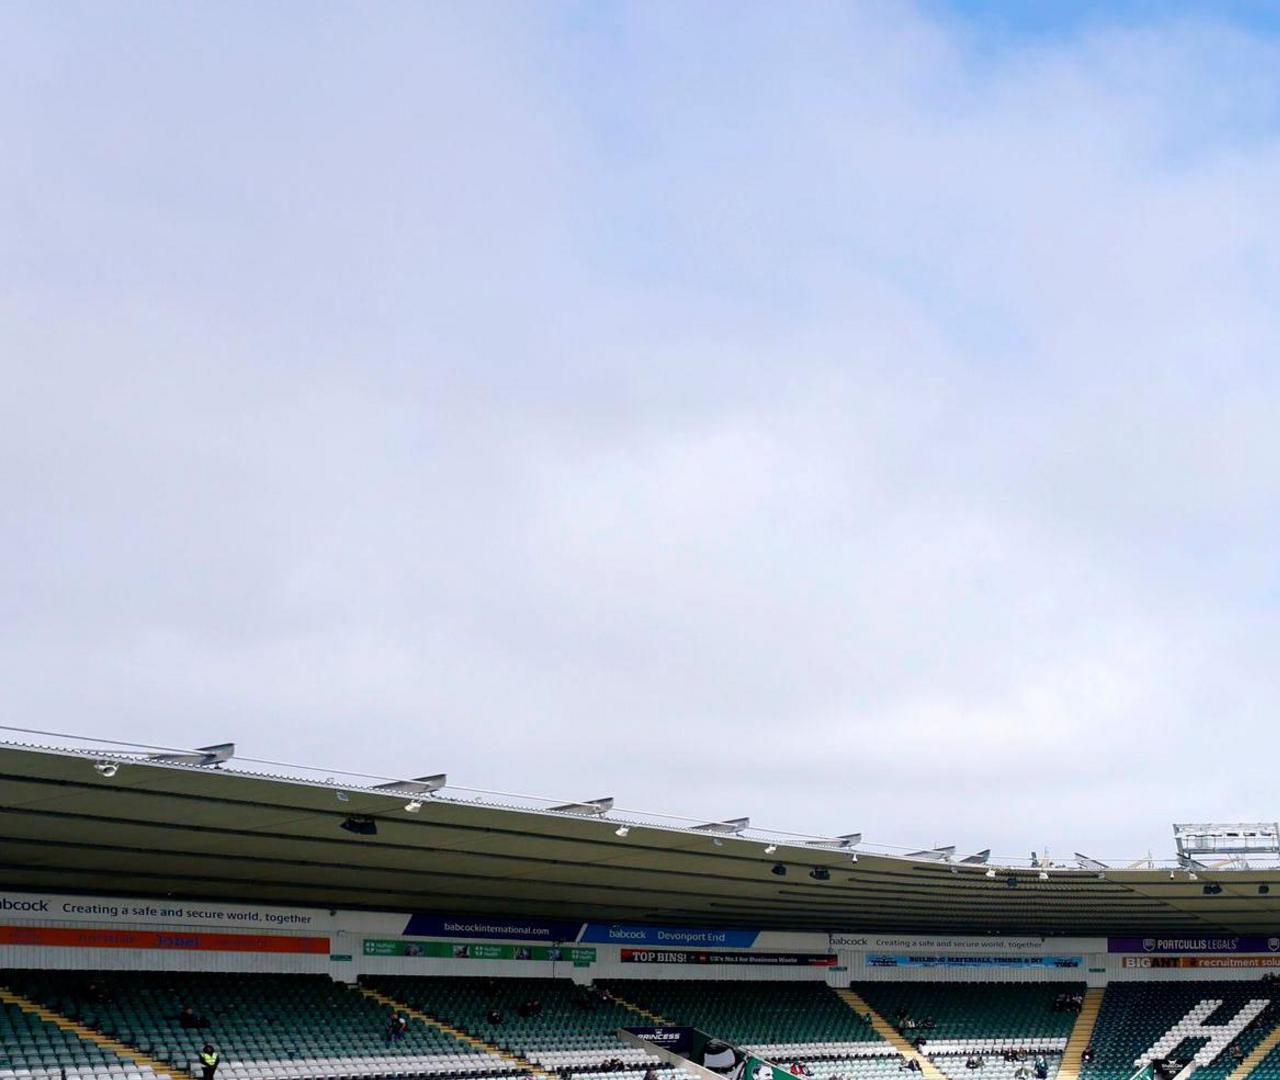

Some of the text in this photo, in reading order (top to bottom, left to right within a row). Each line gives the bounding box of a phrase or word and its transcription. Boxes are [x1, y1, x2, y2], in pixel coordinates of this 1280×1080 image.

[62, 903, 313, 926] Creating a safe and secure world, together
[443, 923, 550, 937] babcockinternational.com
[609, 929, 647, 941] babcock
[657, 930, 726, 945] Devonport End
[828, 937, 868, 947] babcock
[1156, 938, 1236, 950] PORTCULLIS LEGALS
[632, 952, 688, 963] TOP BINS!
[1198, 957, 1257, 967] recruitment
